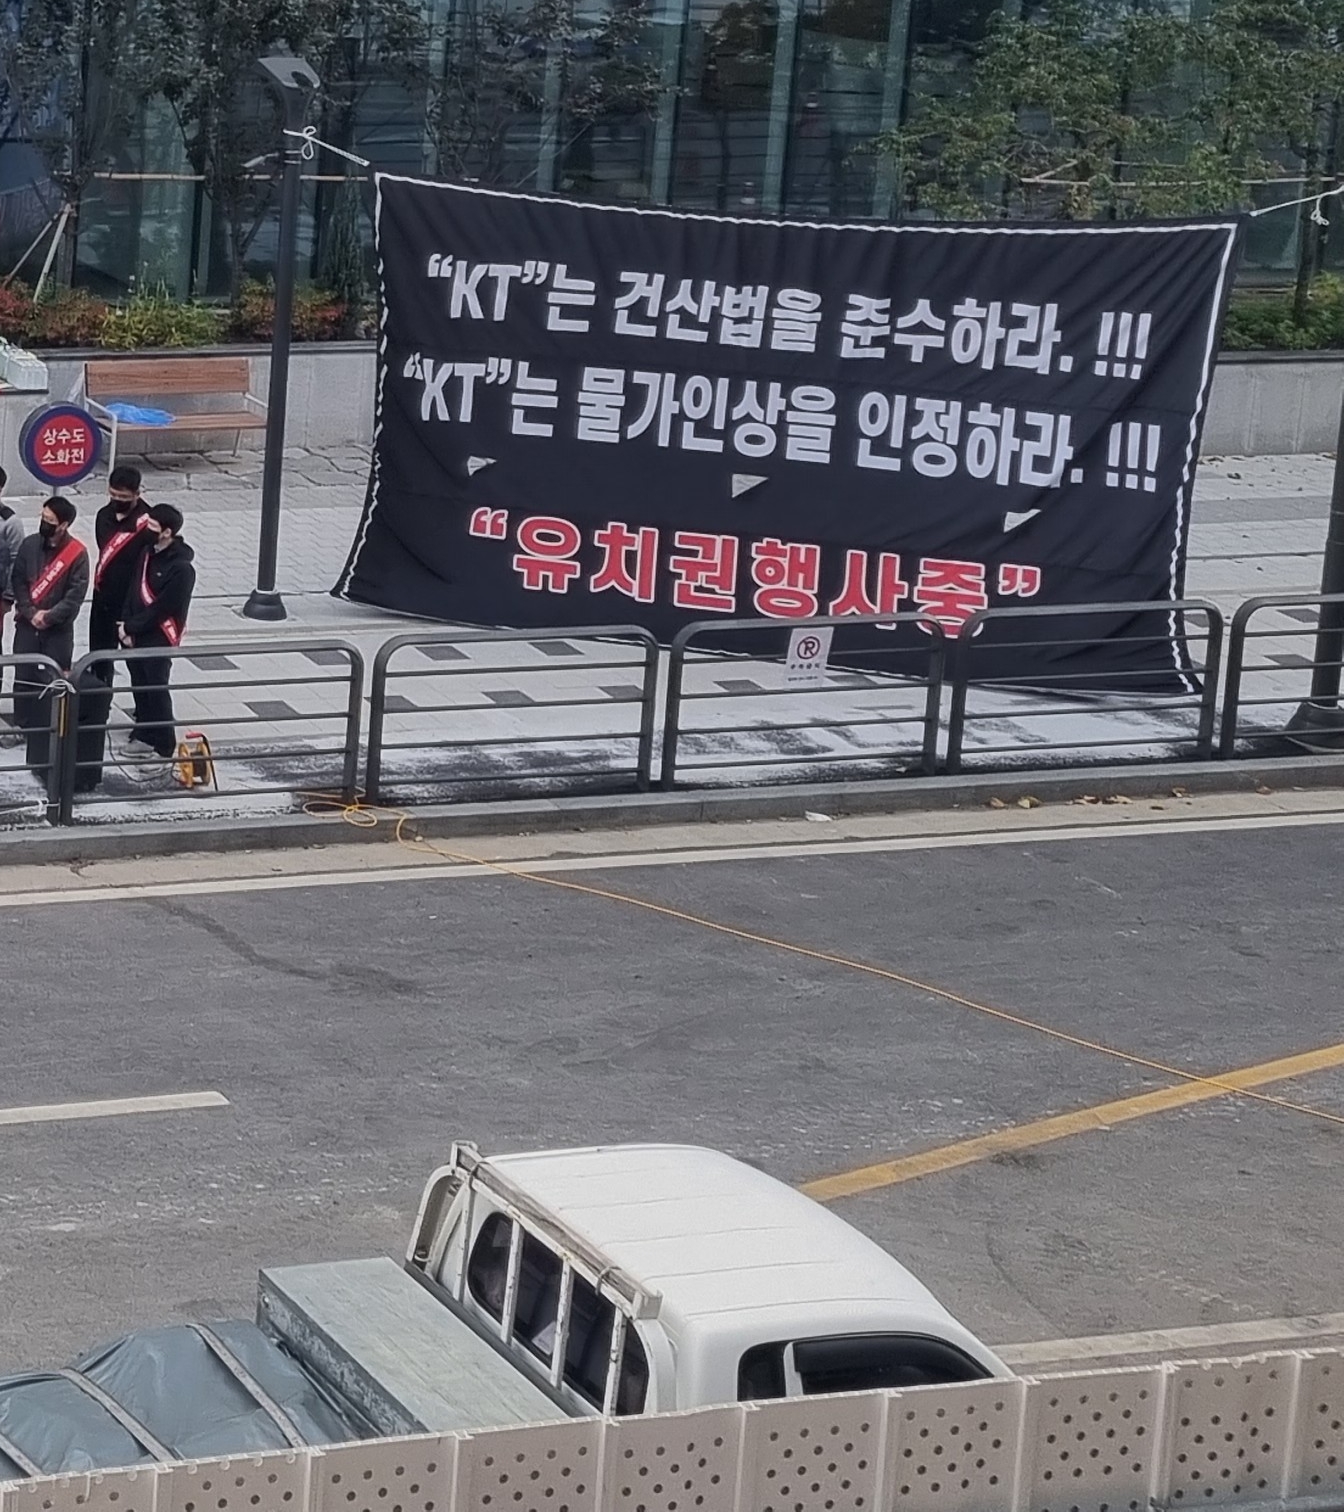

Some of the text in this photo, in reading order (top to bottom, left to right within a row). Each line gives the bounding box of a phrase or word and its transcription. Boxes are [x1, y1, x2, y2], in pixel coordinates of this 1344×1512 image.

[427, 253, 596, 333] “KT”는
[614, 271, 822, 353] 건산법을
[839, 293, 1074, 375] 준수하라.
[41, 448, 84, 465] 소화전
[43, 428, 85, 445] 상수도
[403, 351, 559, 438] “KT”는
[577, 366, 837, 465] 물가인상을
[856, 390, 1084, 489] 인정하라.
[468, 506, 1041, 640] “유치권행사중”
